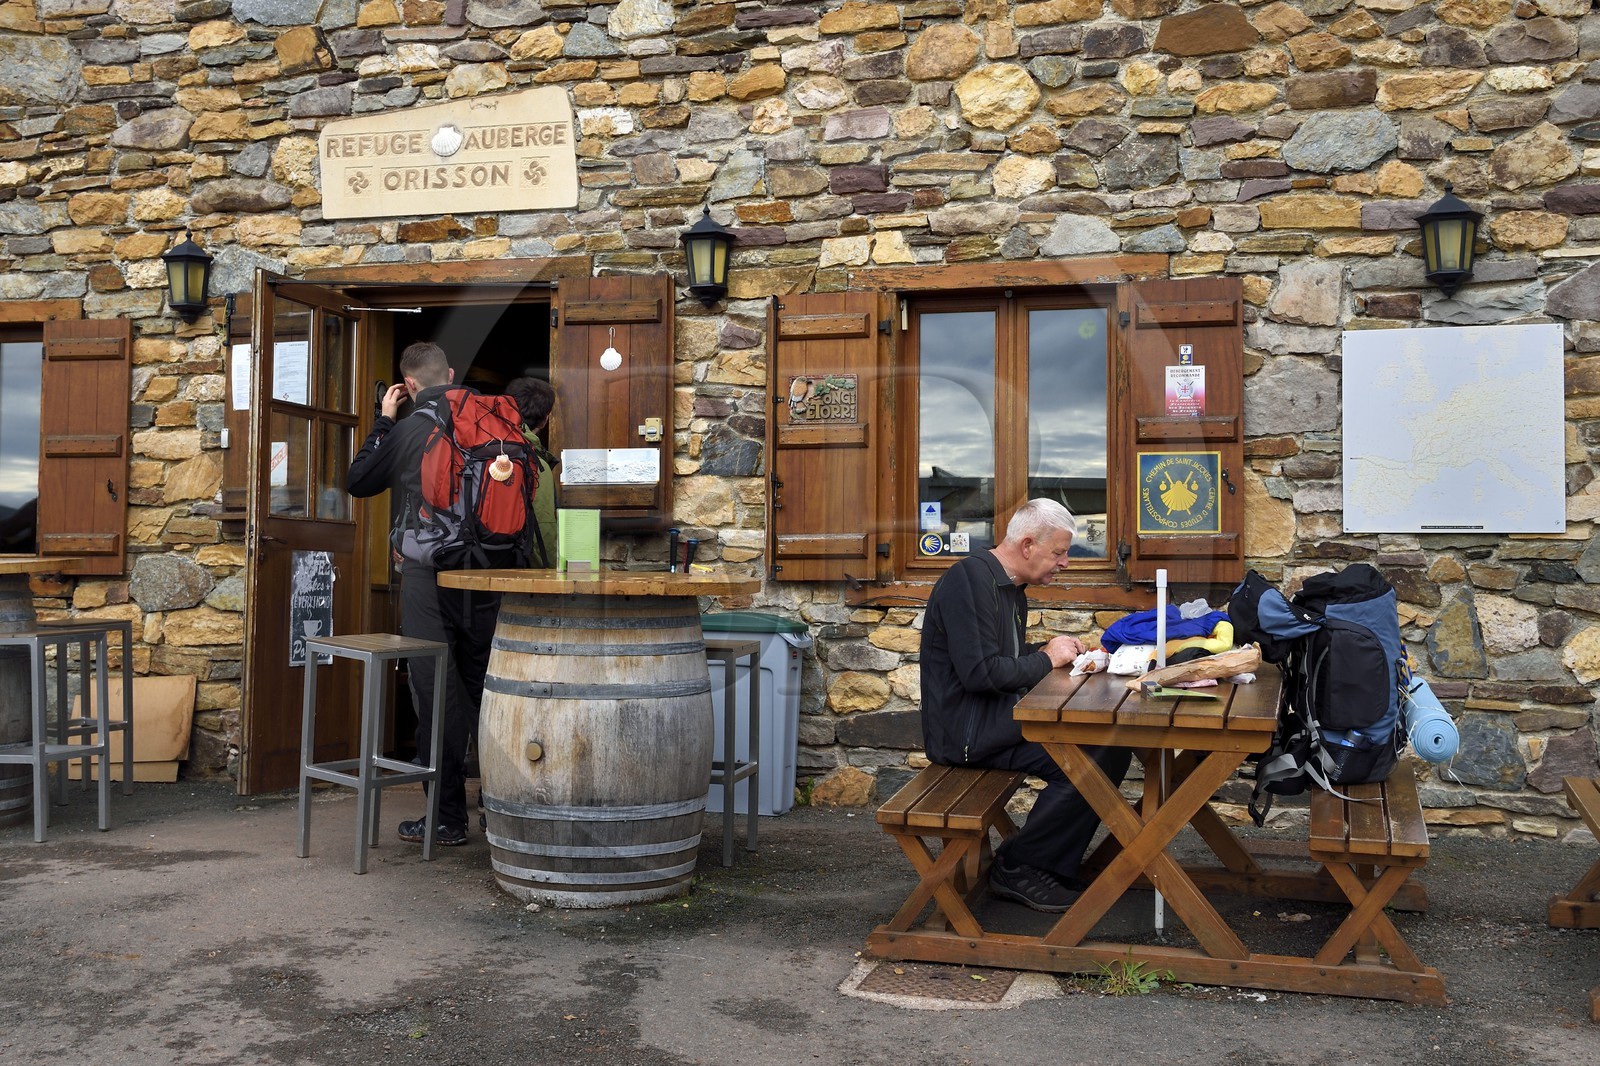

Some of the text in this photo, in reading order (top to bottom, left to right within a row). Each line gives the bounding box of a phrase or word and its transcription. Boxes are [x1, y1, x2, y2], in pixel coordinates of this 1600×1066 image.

[326, 124, 567, 158] REFUGE AUBERGE
[384, 164, 509, 192] ORISSON
[1145, 457, 1213, 483] CHEMIN DE SAINT JACQUES
[1142, 487, 1178, 529] COMPOSTELLANES
[1205, 487, 1216, 511] CENTRE
